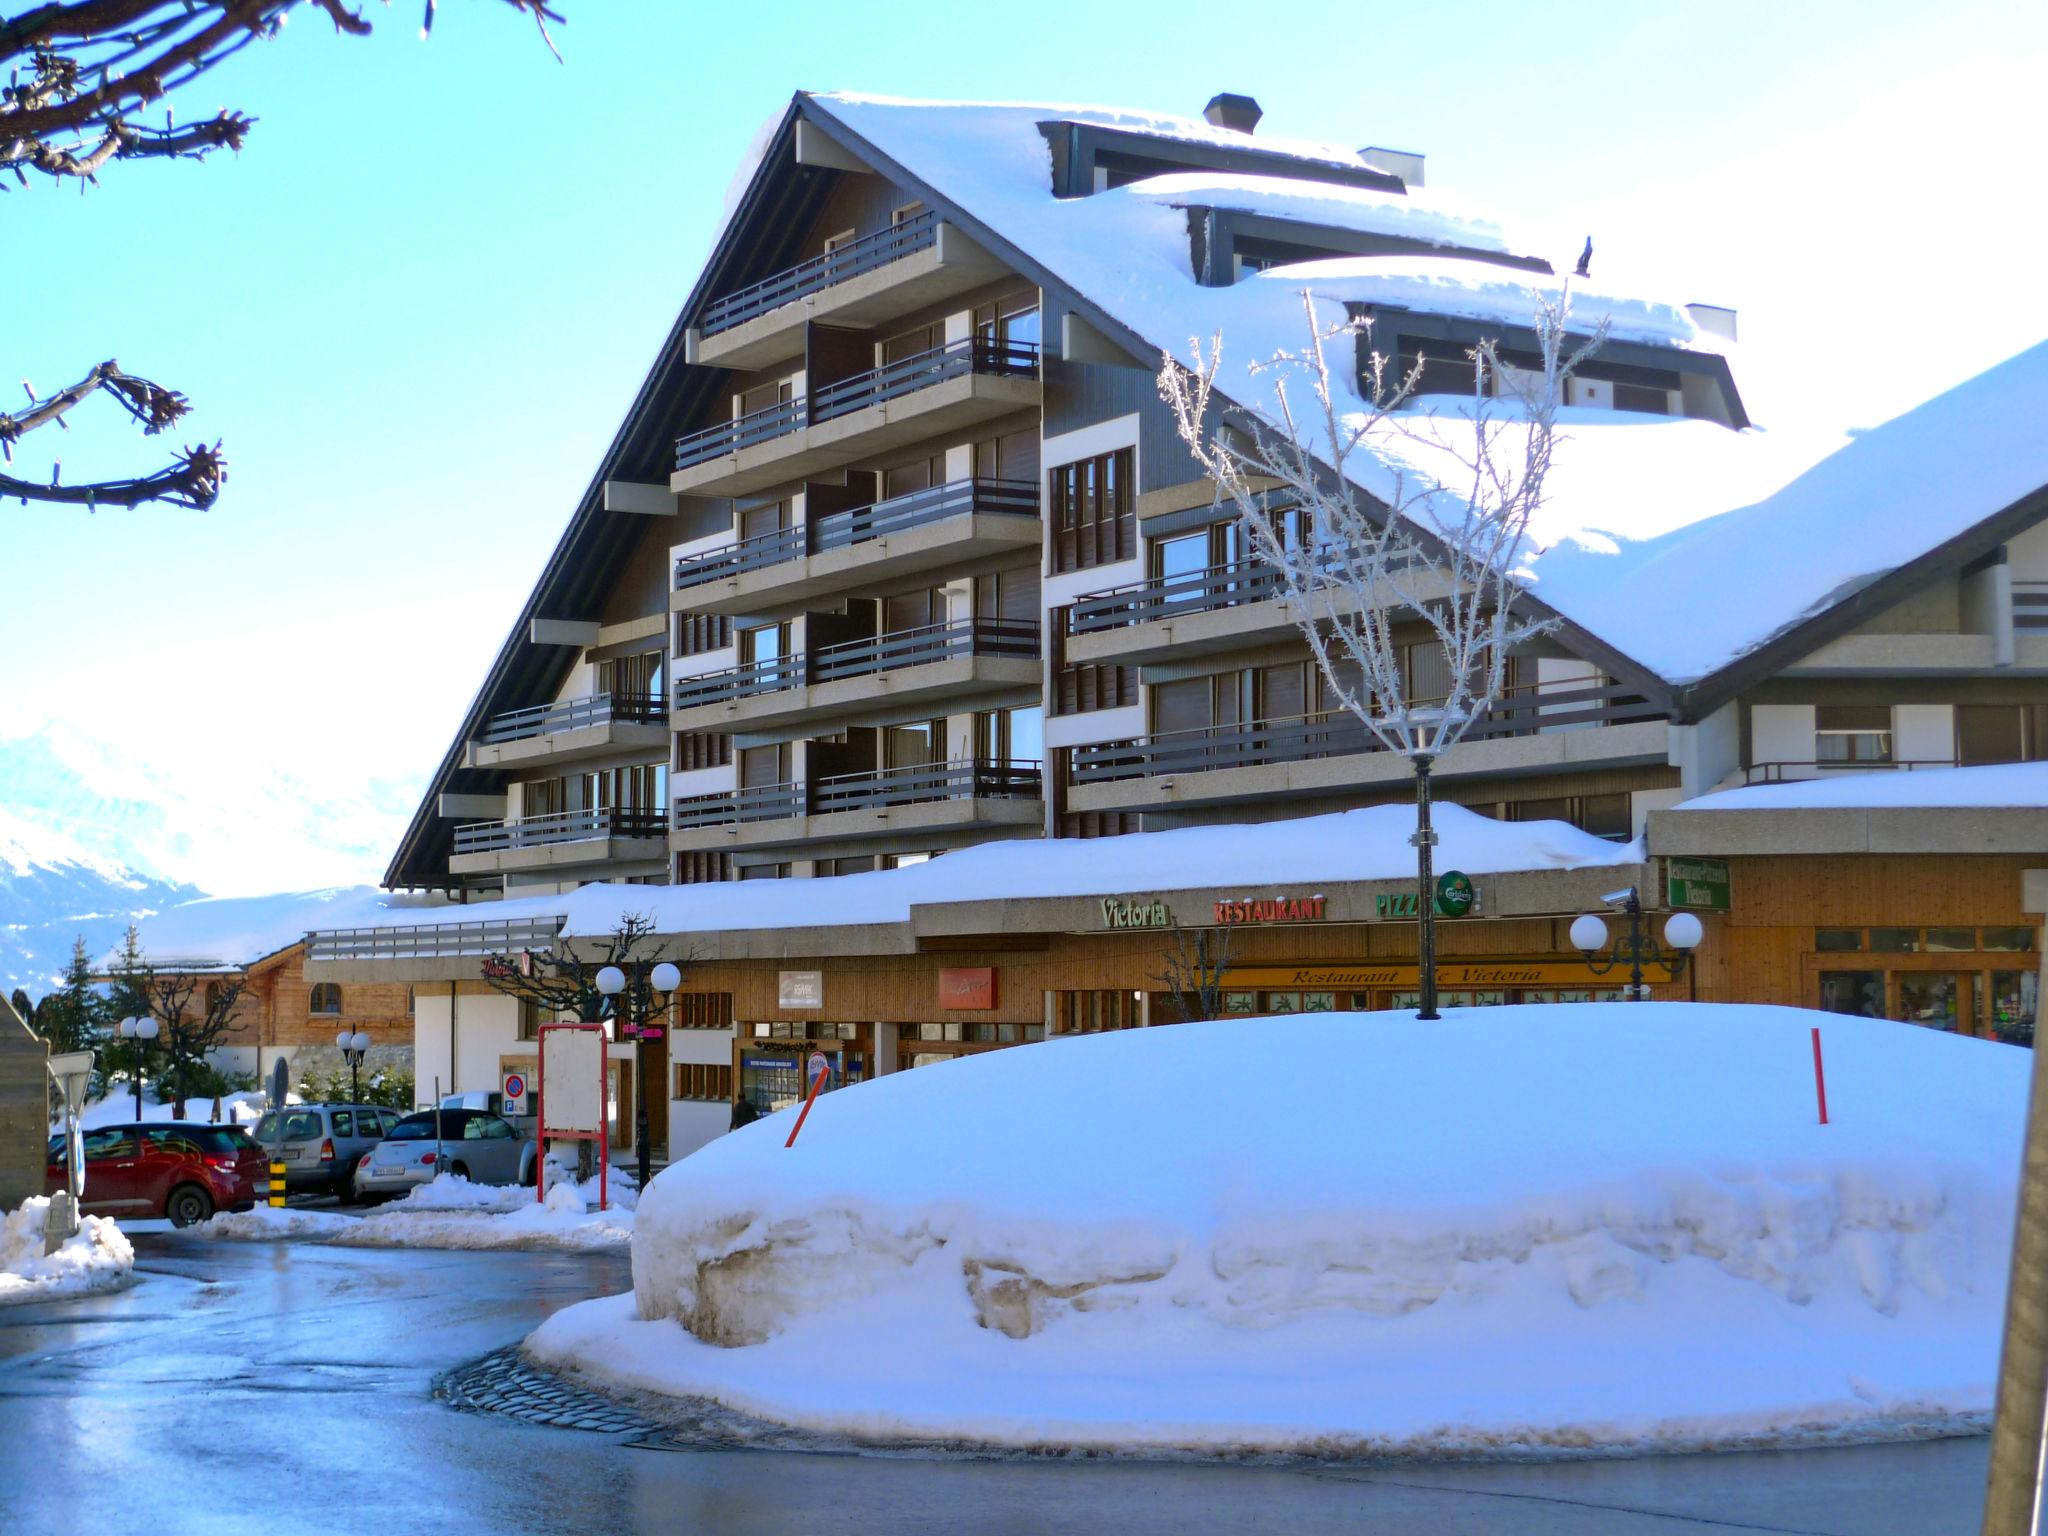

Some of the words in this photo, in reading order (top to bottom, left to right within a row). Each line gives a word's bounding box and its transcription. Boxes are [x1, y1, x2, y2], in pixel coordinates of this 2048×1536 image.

[1099, 898, 1167, 928] Victoria
[1214, 896, 1327, 923] RESTAURANT
[1292, 970, 1399, 983] Restaurant
[1462, 967, 1543, 981] Victoria
